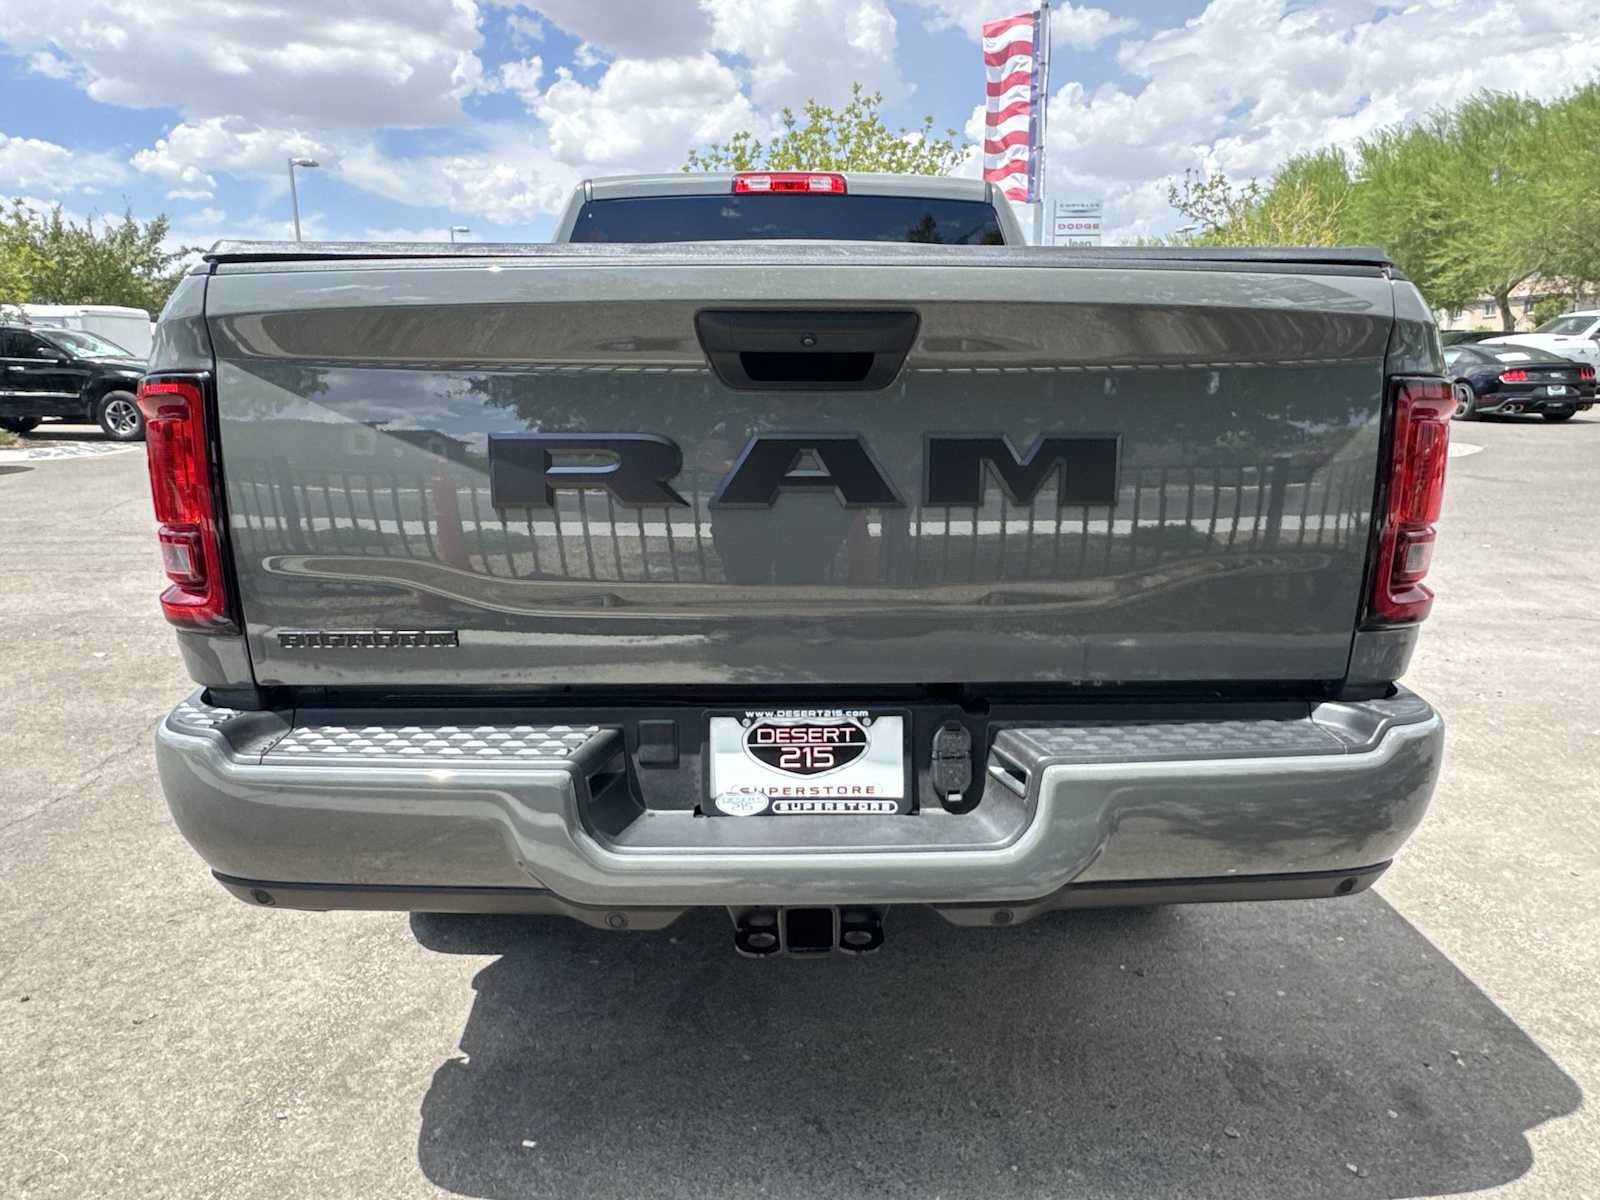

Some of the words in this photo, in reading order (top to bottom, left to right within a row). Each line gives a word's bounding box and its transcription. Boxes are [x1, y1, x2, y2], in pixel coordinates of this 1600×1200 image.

[488, 432, 1123, 508] RAM
[745, 709, 869, 718] www.DESERT215.com
[756, 727, 857, 743] DESERT
[779, 747, 834, 768] 215
[739, 785, 876, 796] SUPERSTORE
[779, 801, 891, 811] SUPERSTORE
